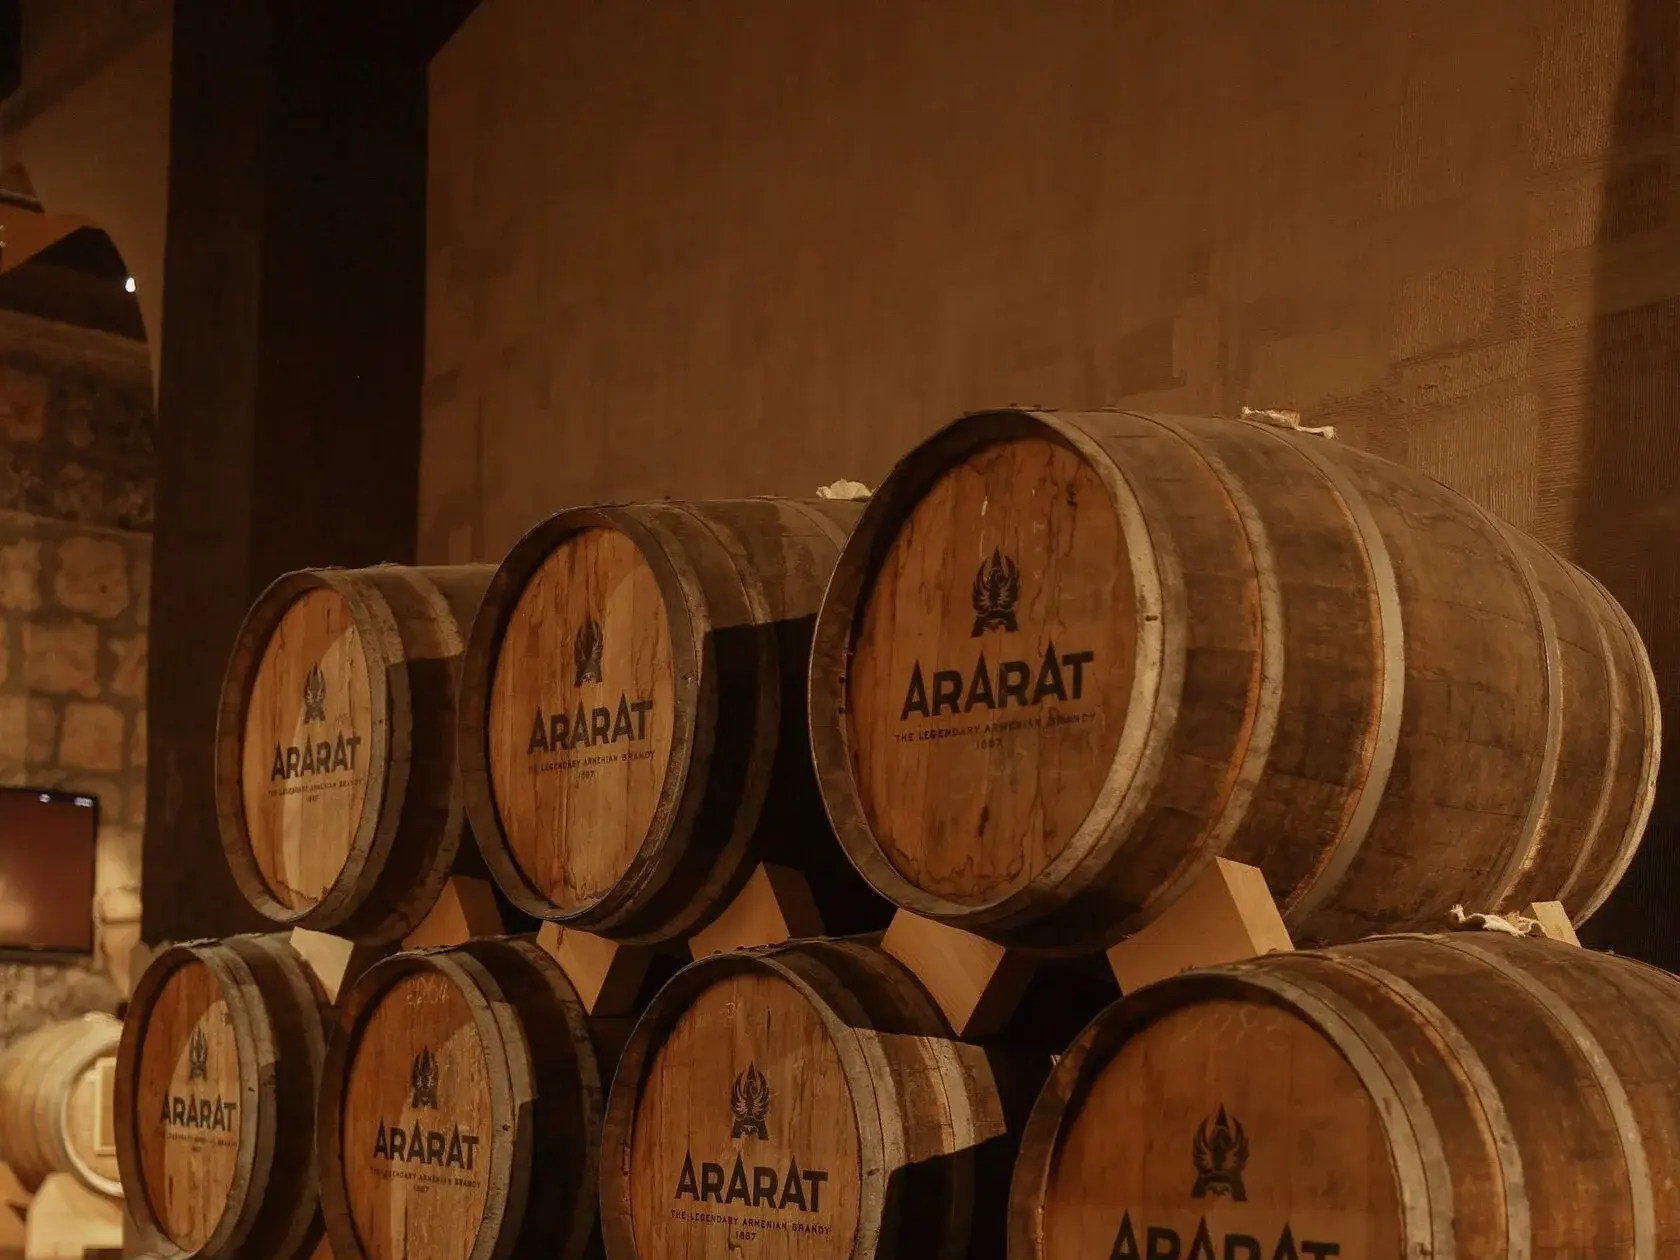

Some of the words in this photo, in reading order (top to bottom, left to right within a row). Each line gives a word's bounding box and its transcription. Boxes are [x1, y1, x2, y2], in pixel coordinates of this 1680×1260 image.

[900, 639, 1095, 722] ARARAT
[527, 693, 654, 755] ARARAT
[895, 732, 914, 743] THE
[271, 730, 362, 782] ARARAT
[160, 1088, 237, 1132] ARARAT
[373, 1114, 479, 1170] ARARAT
[674, 1149, 828, 1213] ARARAT
[671, 1210, 686, 1220] THE
[690, 1212, 738, 1225] LEGENDARY
[743, 1218, 787, 1230] ARMENIAN
[792, 1224, 830, 1235] BRANDY
